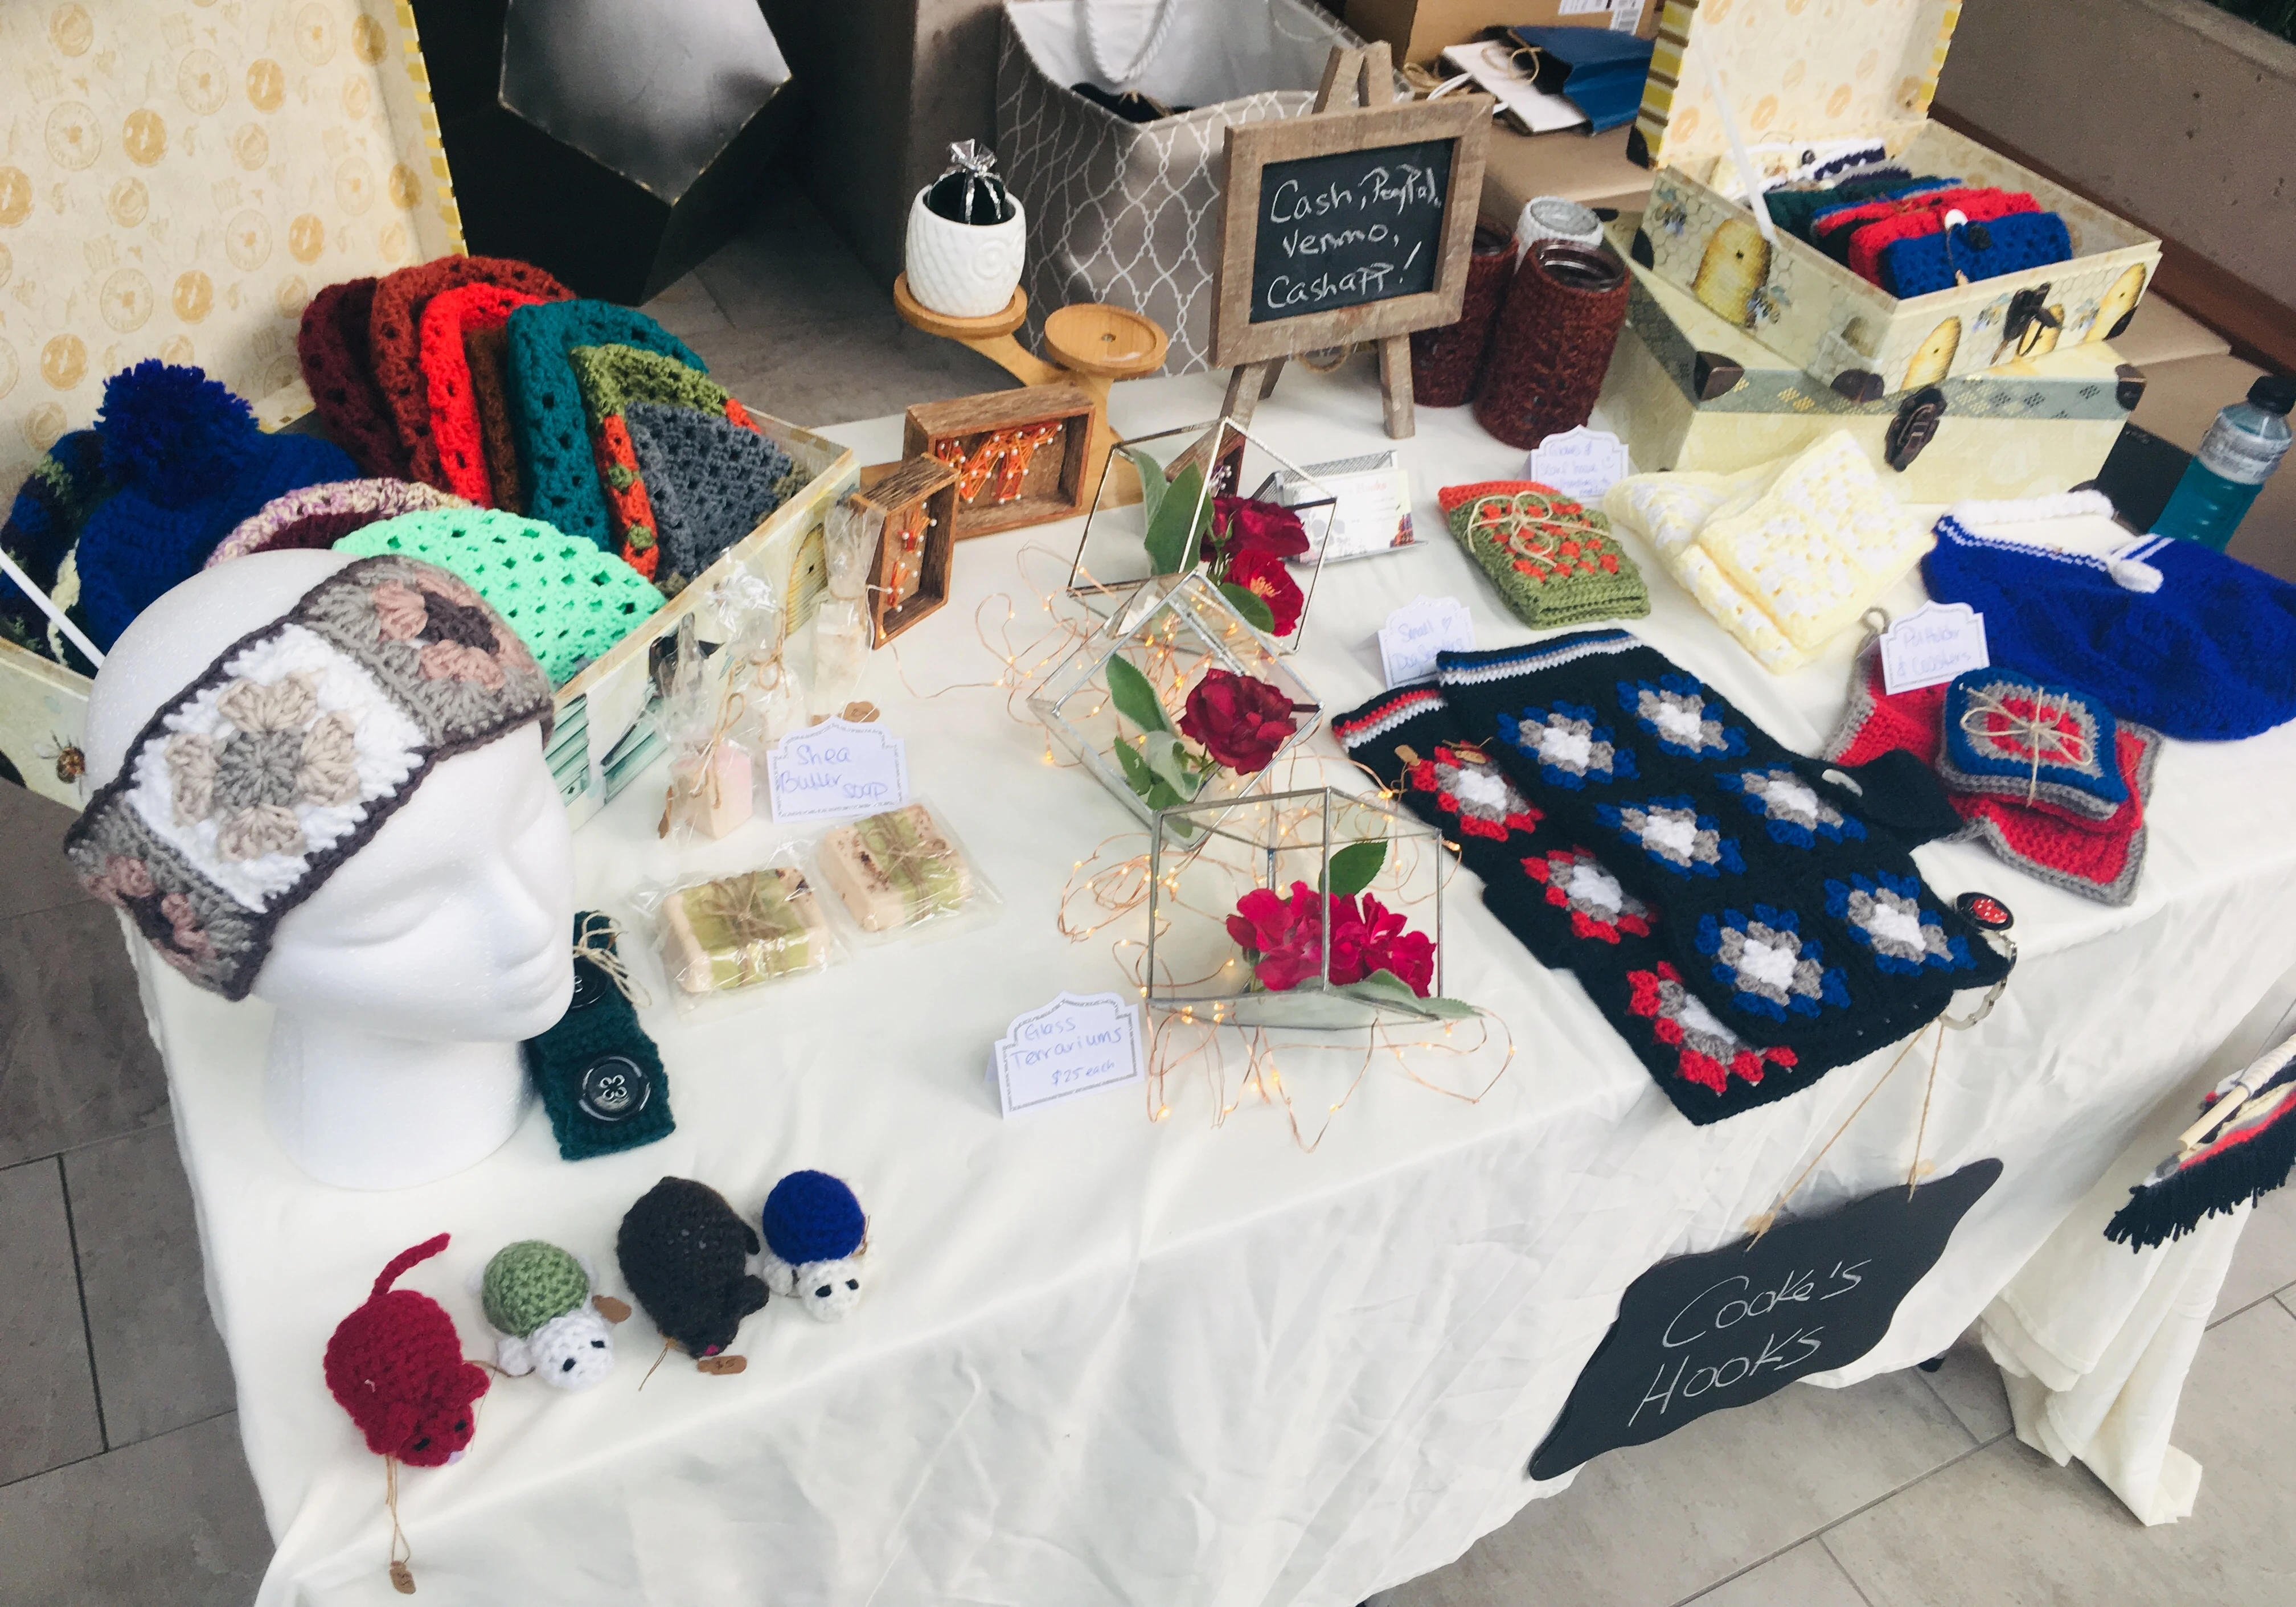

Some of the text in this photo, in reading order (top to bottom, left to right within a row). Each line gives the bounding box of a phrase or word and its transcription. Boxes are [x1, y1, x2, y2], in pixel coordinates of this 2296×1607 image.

[797, 744, 853, 765] Shea
[1025, 1016, 1077, 1041] Glass
[1010, 1027, 1122, 1069] Terrariums
[1051, 1059, 1115, 1087] $25 each
[1662, 1258, 1873, 1348] Cooke's
